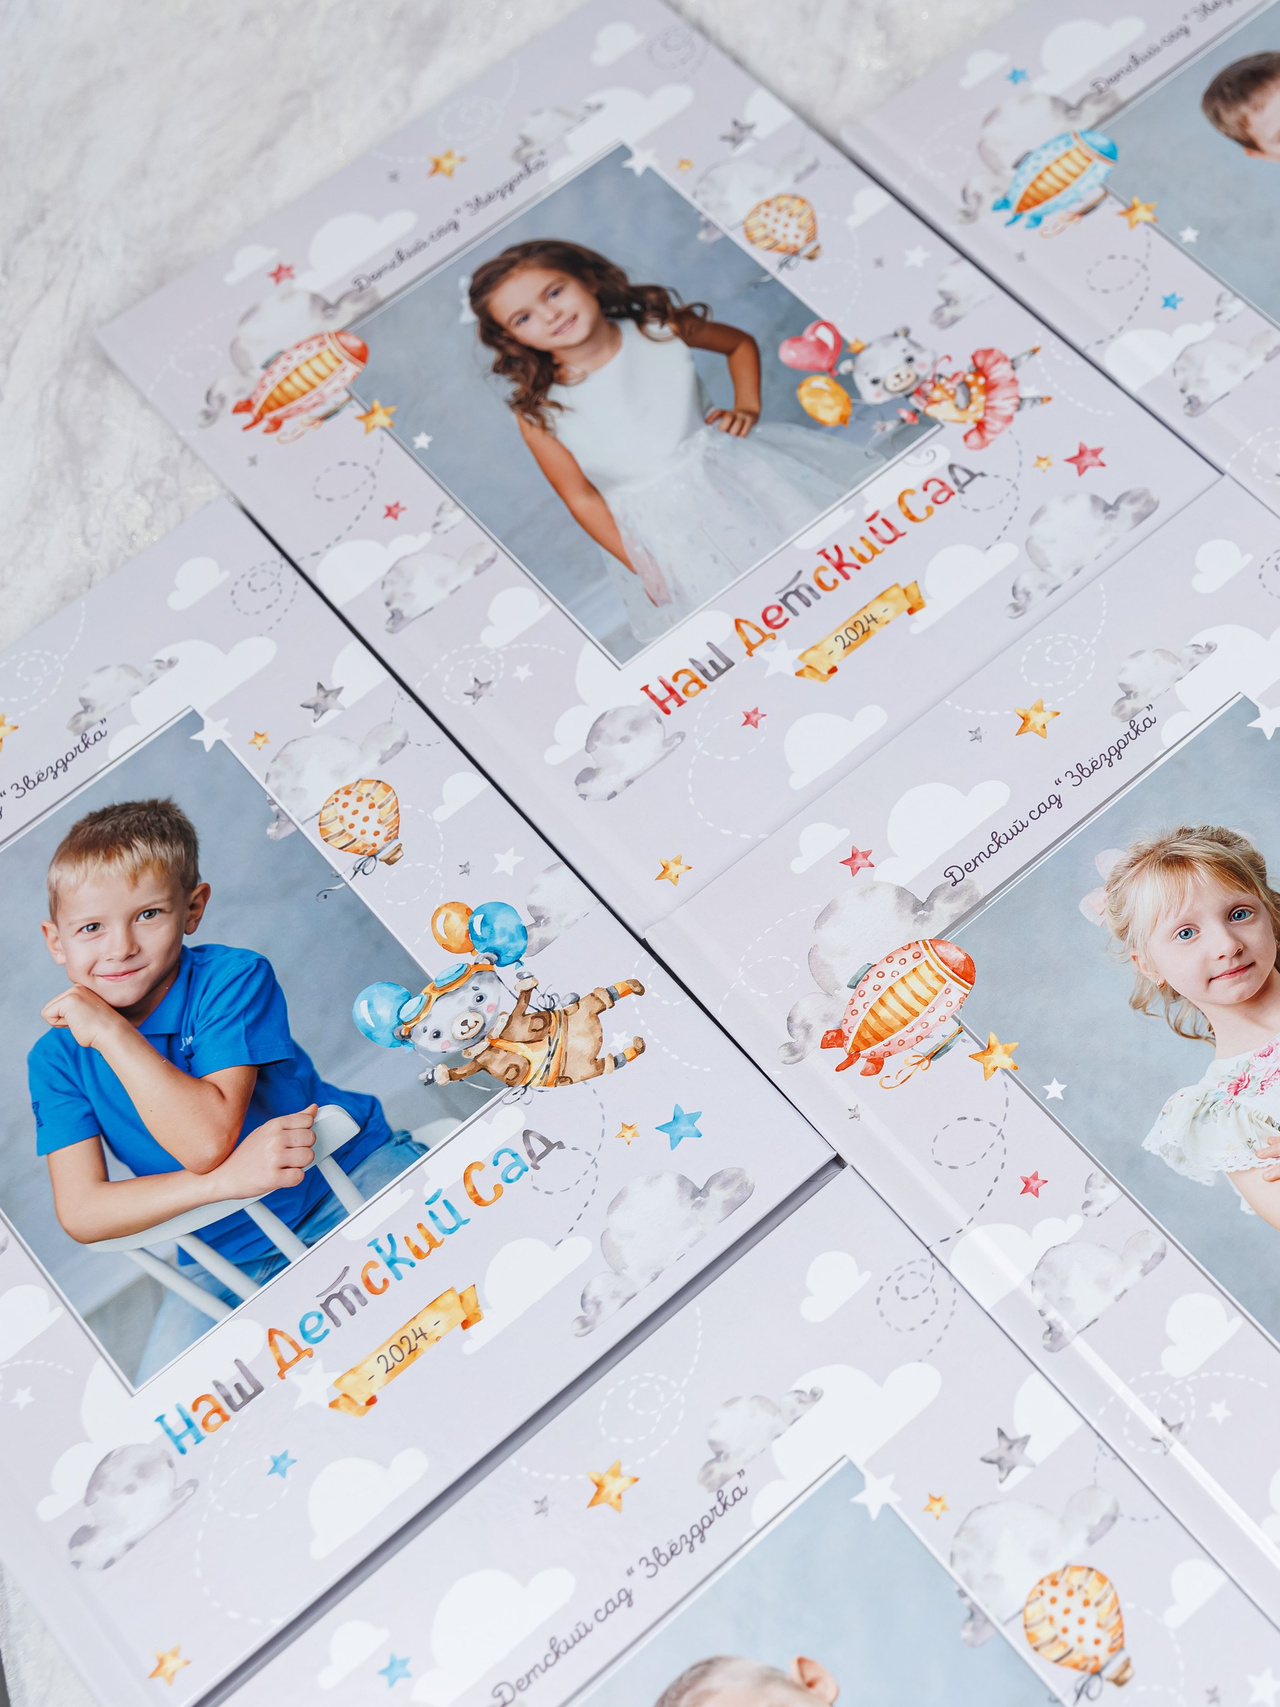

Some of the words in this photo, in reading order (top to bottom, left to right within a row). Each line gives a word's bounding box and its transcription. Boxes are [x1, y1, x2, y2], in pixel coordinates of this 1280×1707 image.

[640, 642, 735, 715] Наш
[897, 463, 987, 523] Сад
[943, 819, 1028, 887] Детский
[1028, 793, 1062, 820] сад
[154, 1357, 265, 1455] Наш
[463, 1129, 566, 1207] Сад
[594, 1587, 633, 1623] сад
